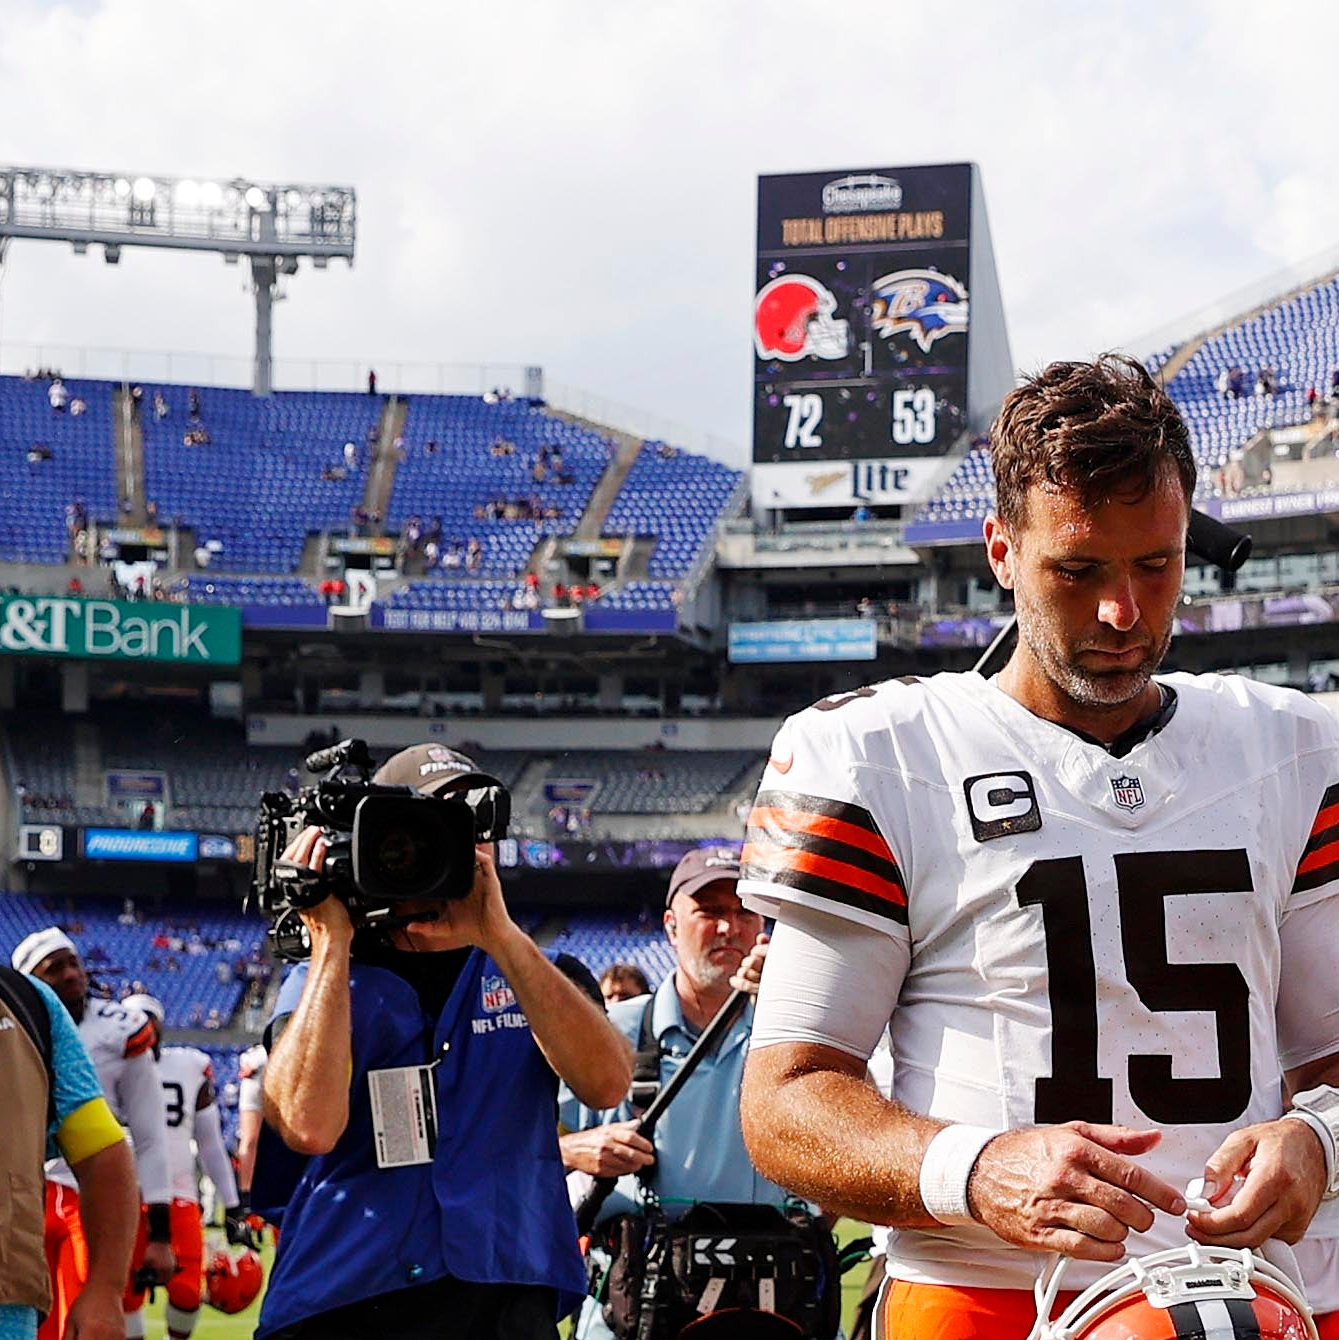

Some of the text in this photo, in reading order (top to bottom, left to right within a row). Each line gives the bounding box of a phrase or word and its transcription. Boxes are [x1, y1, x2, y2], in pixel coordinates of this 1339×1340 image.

[782, 210, 944, 246] TOTAL OFFENSIVE PLAYS
[782, 388, 935, 449] 72 53
[851, 461, 909, 501] Lite
[84, 600, 211, 660] Bank
[969, 775, 1033, 823] C
[1115, 787, 1143, 806] NFL
[485, 988, 514, 1008] NFL
[1014, 847, 1255, 1125] 15
[471, 1012, 529, 1034] NFL FILMS
